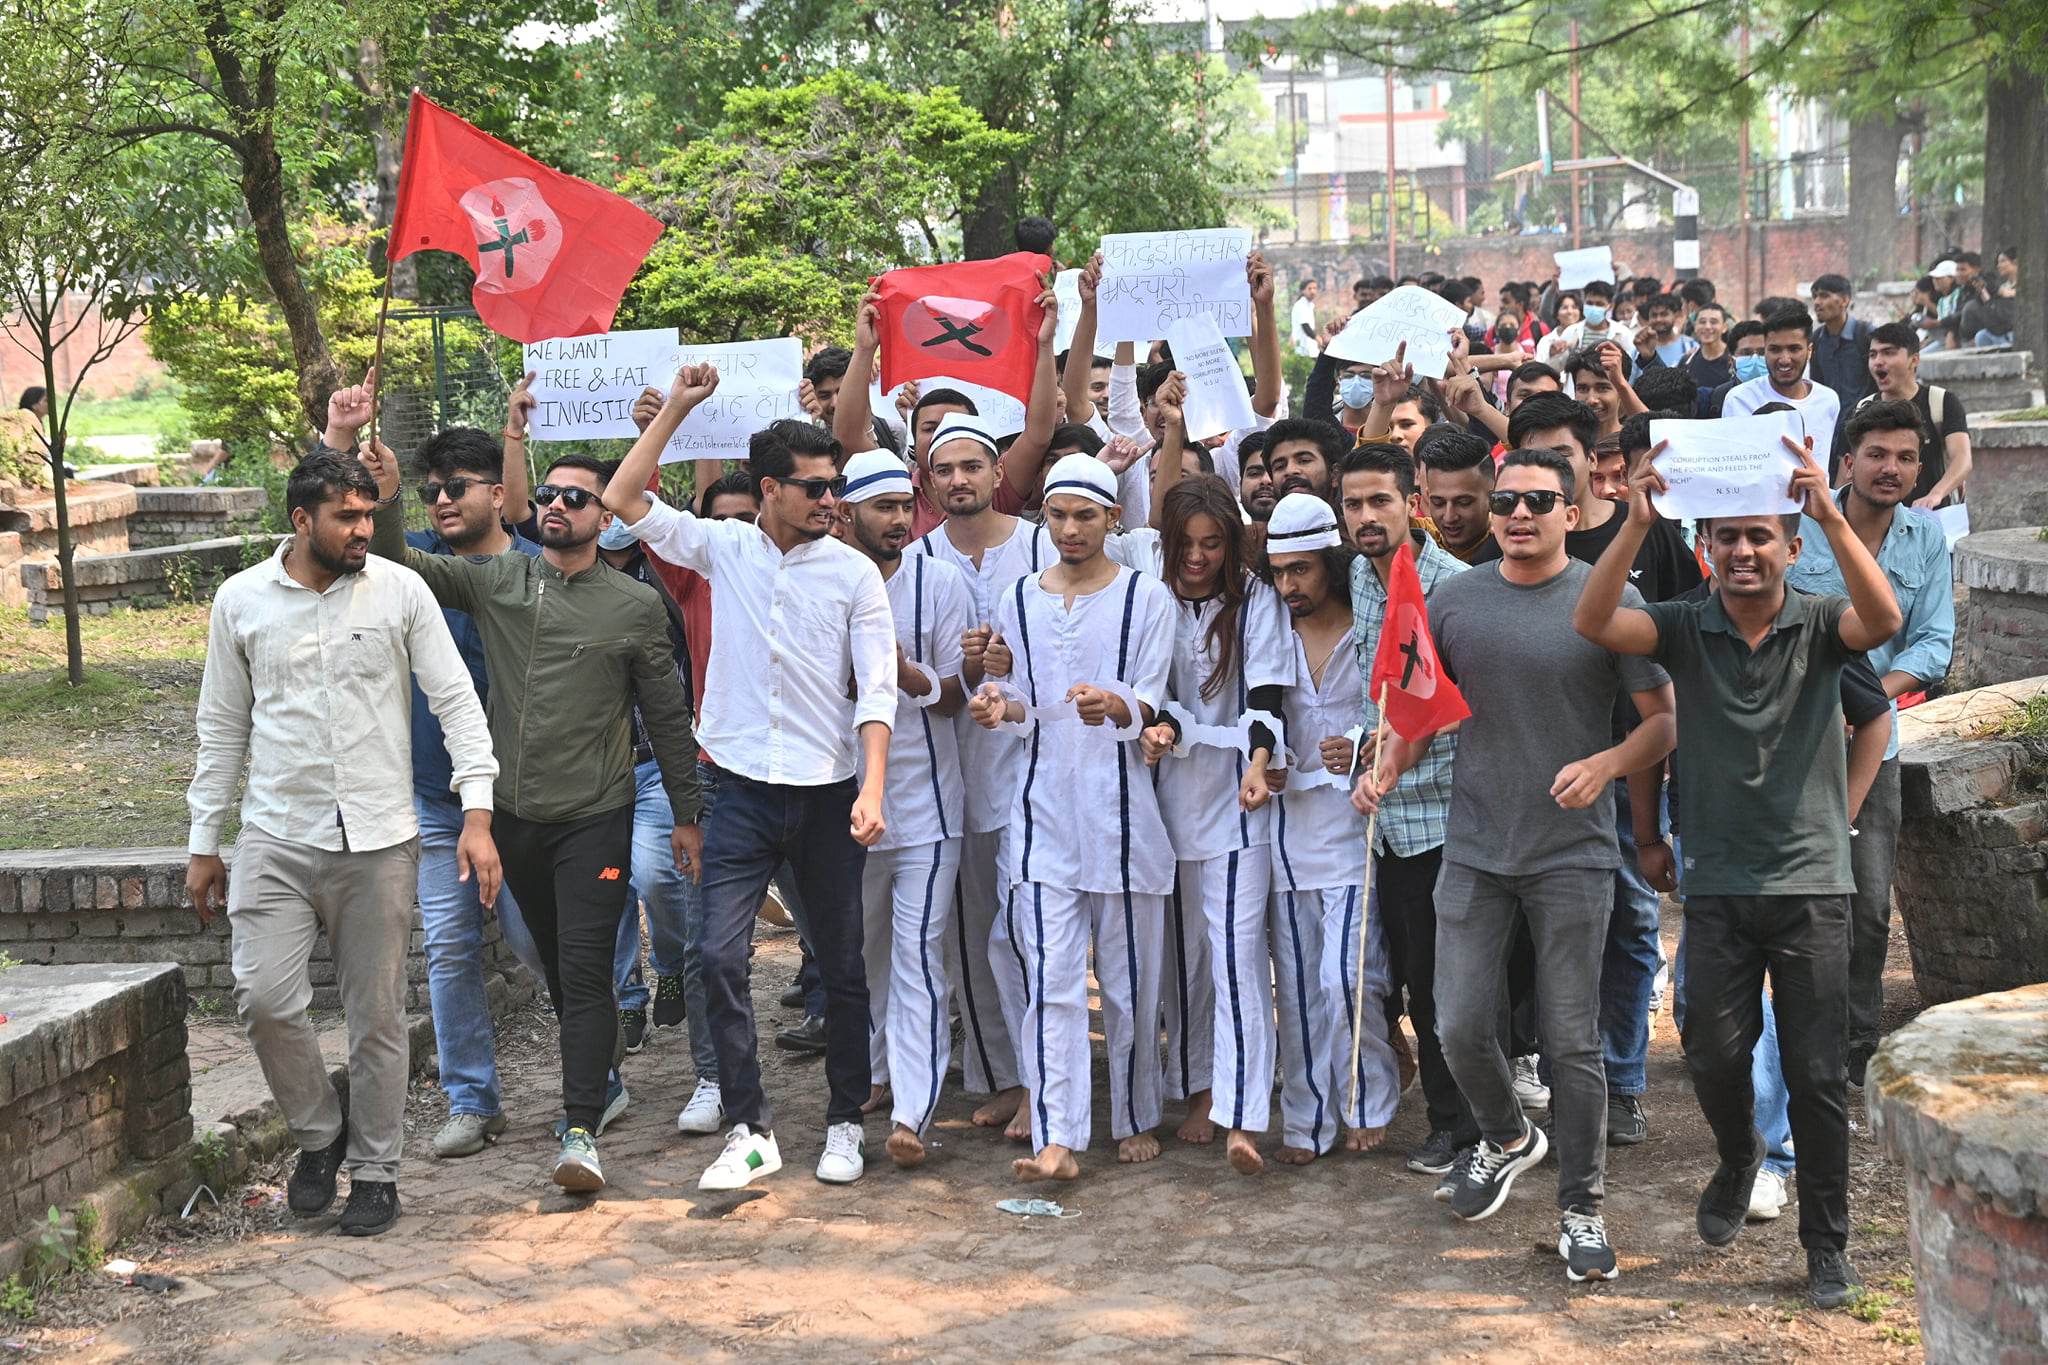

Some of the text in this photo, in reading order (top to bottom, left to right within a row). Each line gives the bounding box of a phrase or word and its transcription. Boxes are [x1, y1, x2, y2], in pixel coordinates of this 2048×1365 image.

[527, 339, 613, 361] WE WANT
[540, 367, 650, 393] FREE & FAI
[1722, 454, 1748, 462] STEALS
[1749, 452, 1771, 461] FROM
[1669, 467, 1683, 475] THE
[1708, 465, 1724, 473] AND
[1749, 463, 1763, 471] THE
